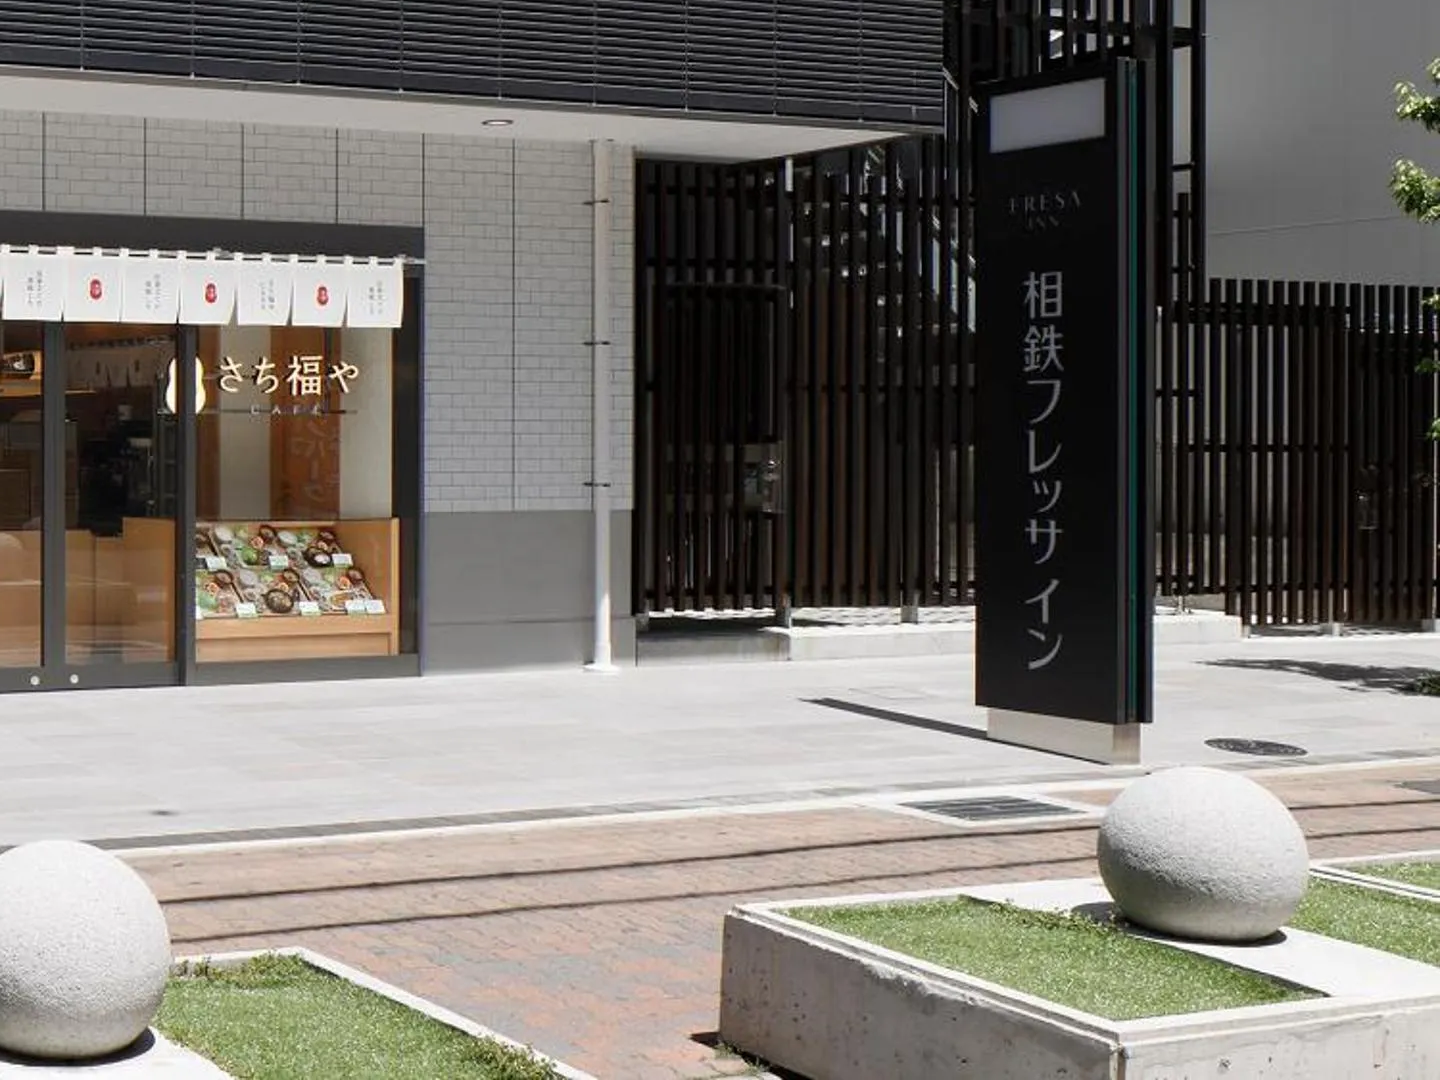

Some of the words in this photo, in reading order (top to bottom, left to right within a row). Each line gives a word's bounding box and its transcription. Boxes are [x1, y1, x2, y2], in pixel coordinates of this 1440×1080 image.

[218, 354, 360, 396] さち福や
[1022, 270, 1065, 670] 相鉄フレッサイン
